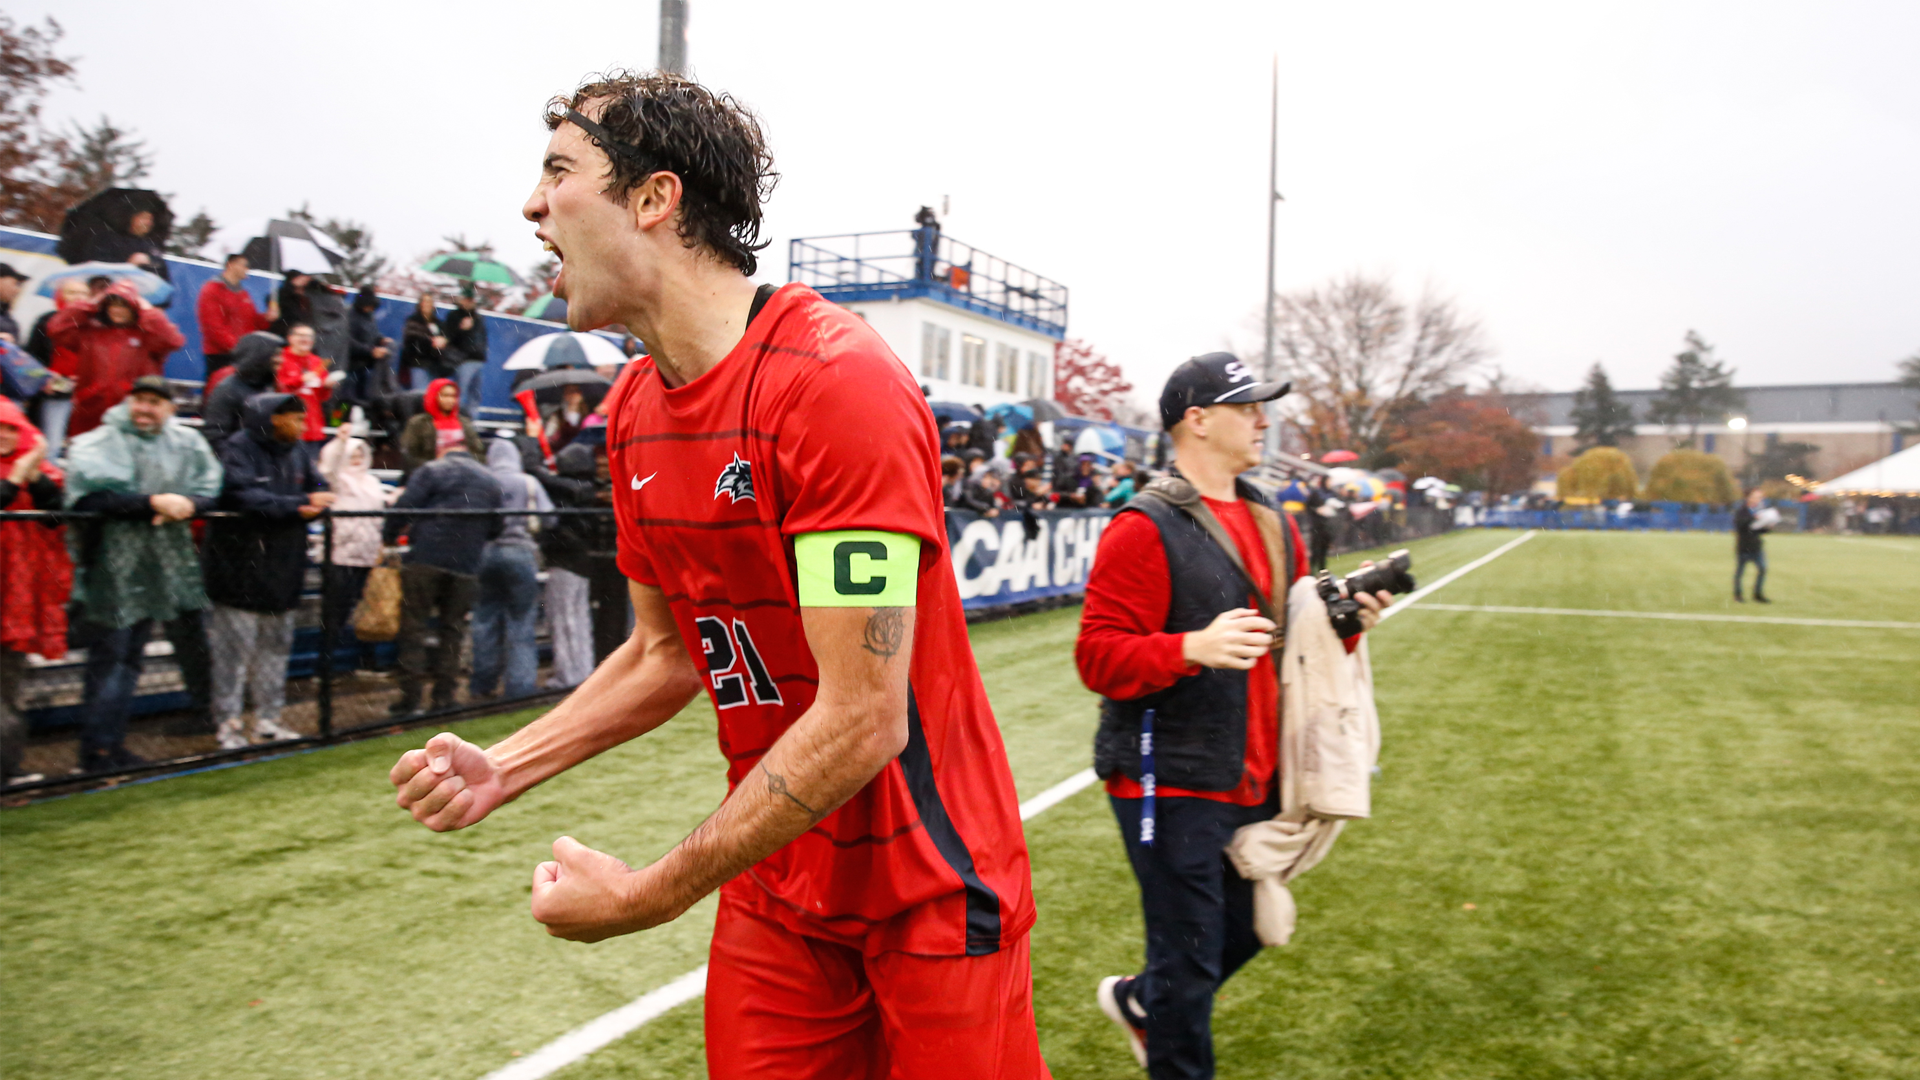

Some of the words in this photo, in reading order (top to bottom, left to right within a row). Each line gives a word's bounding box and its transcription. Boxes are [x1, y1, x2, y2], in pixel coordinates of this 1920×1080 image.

[833, 541, 888, 595] C
[952, 519, 1050, 600] CAA
[1053, 516, 1111, 587] CH
[695, 615, 784, 710] 21
